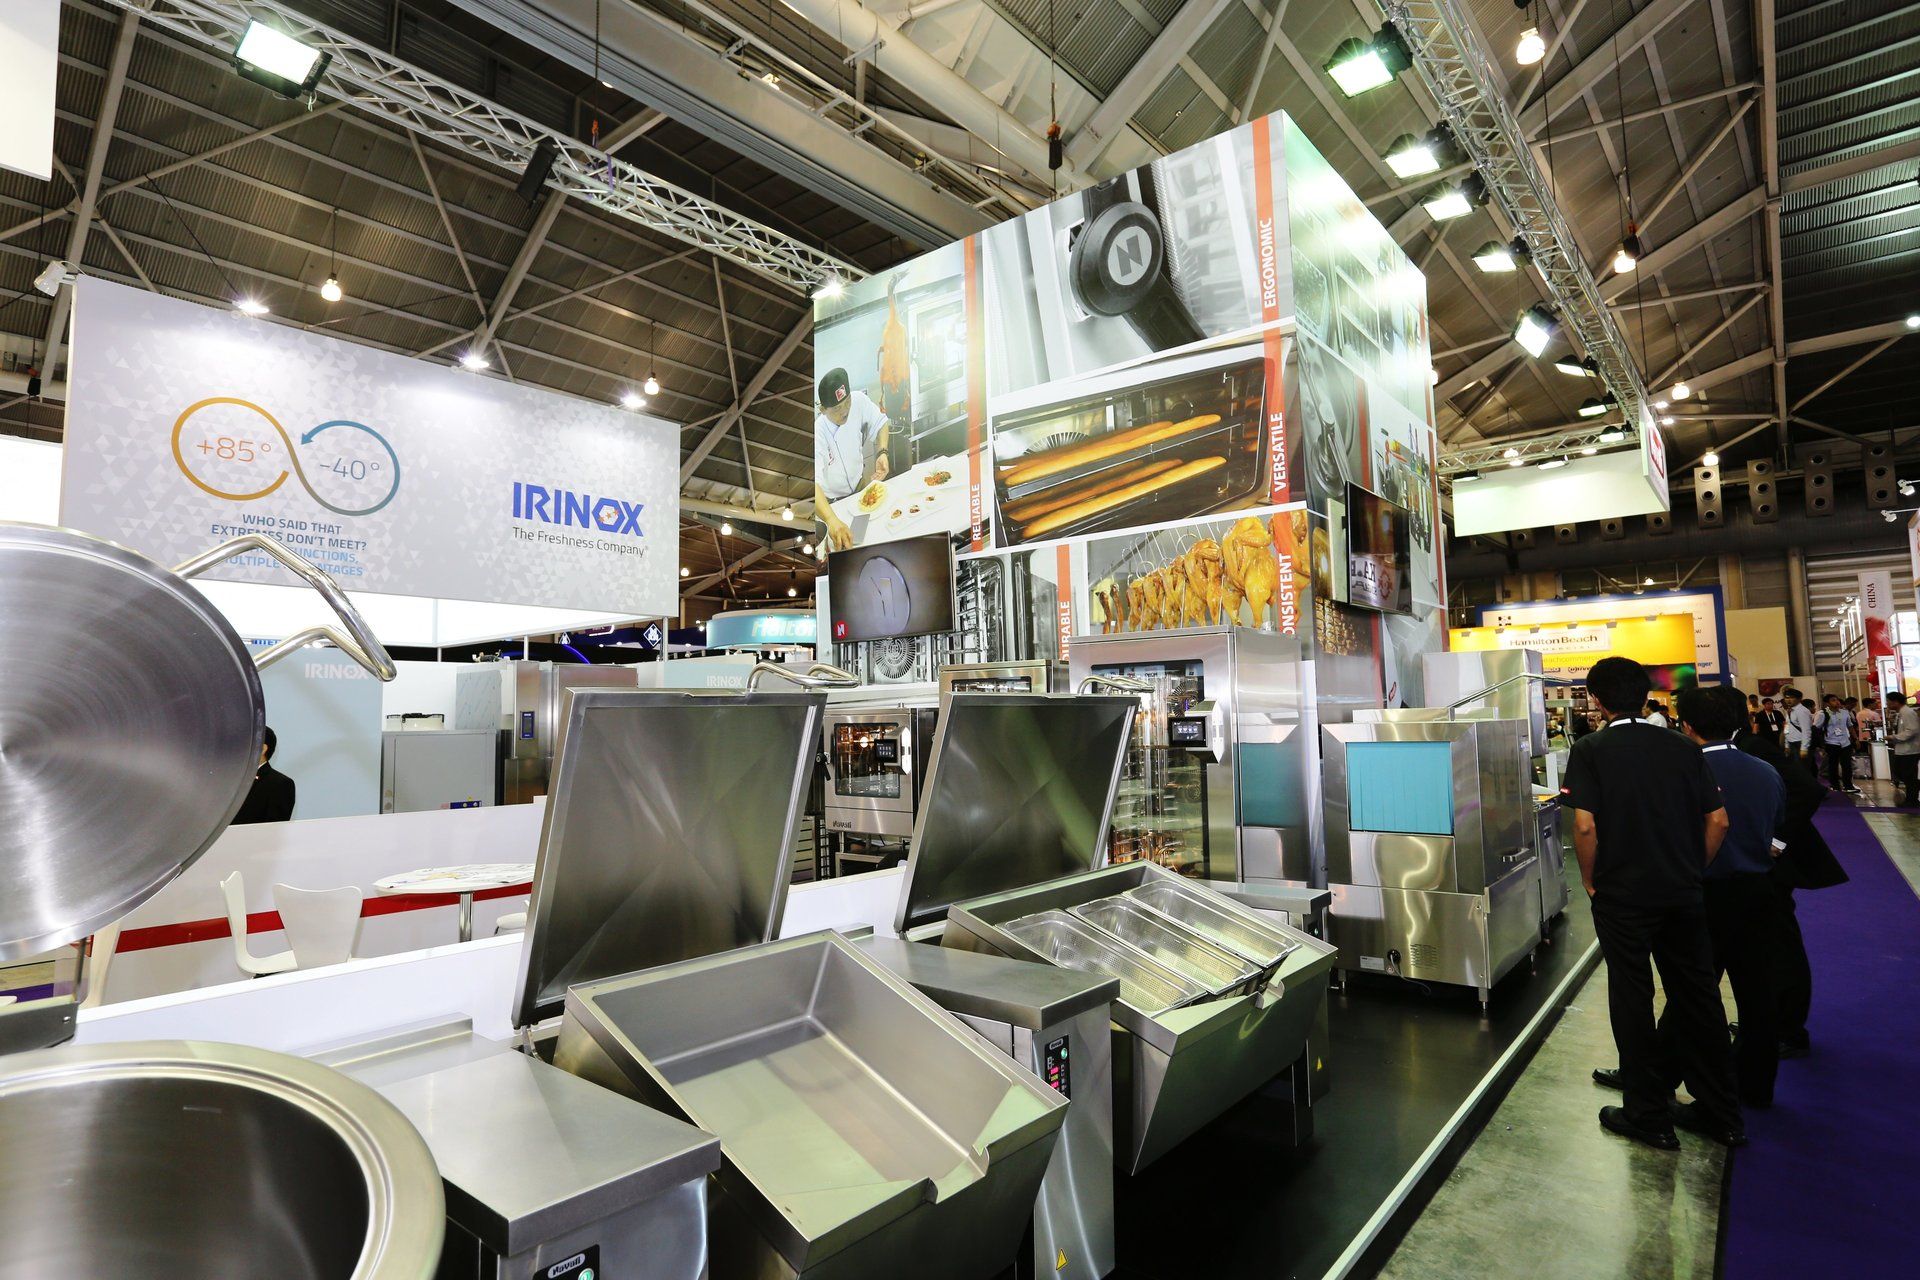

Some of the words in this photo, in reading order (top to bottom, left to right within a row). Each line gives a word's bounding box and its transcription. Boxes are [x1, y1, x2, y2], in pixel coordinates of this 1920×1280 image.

[1260, 217, 1277, 308] ERGONOMIC
[1270, 412, 1287, 492] VERSATILE
[512, 481, 645, 537] IRINOX
[971, 483, 981, 541] RELIABLE
[243, 514, 275, 527] WHO
[279, 518, 307, 531] SAID
[311, 522, 342, 535] THAT
[512, 526, 534, 541] The
[537, 531, 594, 549] Freshness
[328, 539, 367, 551] MEET?
[1279, 553, 1295, 635] ONSISTENT
[1867, 582, 1876, 609] CHINA
[304, 663, 369, 679] IRINOX
[706, 675, 742, 686] IRINOX
